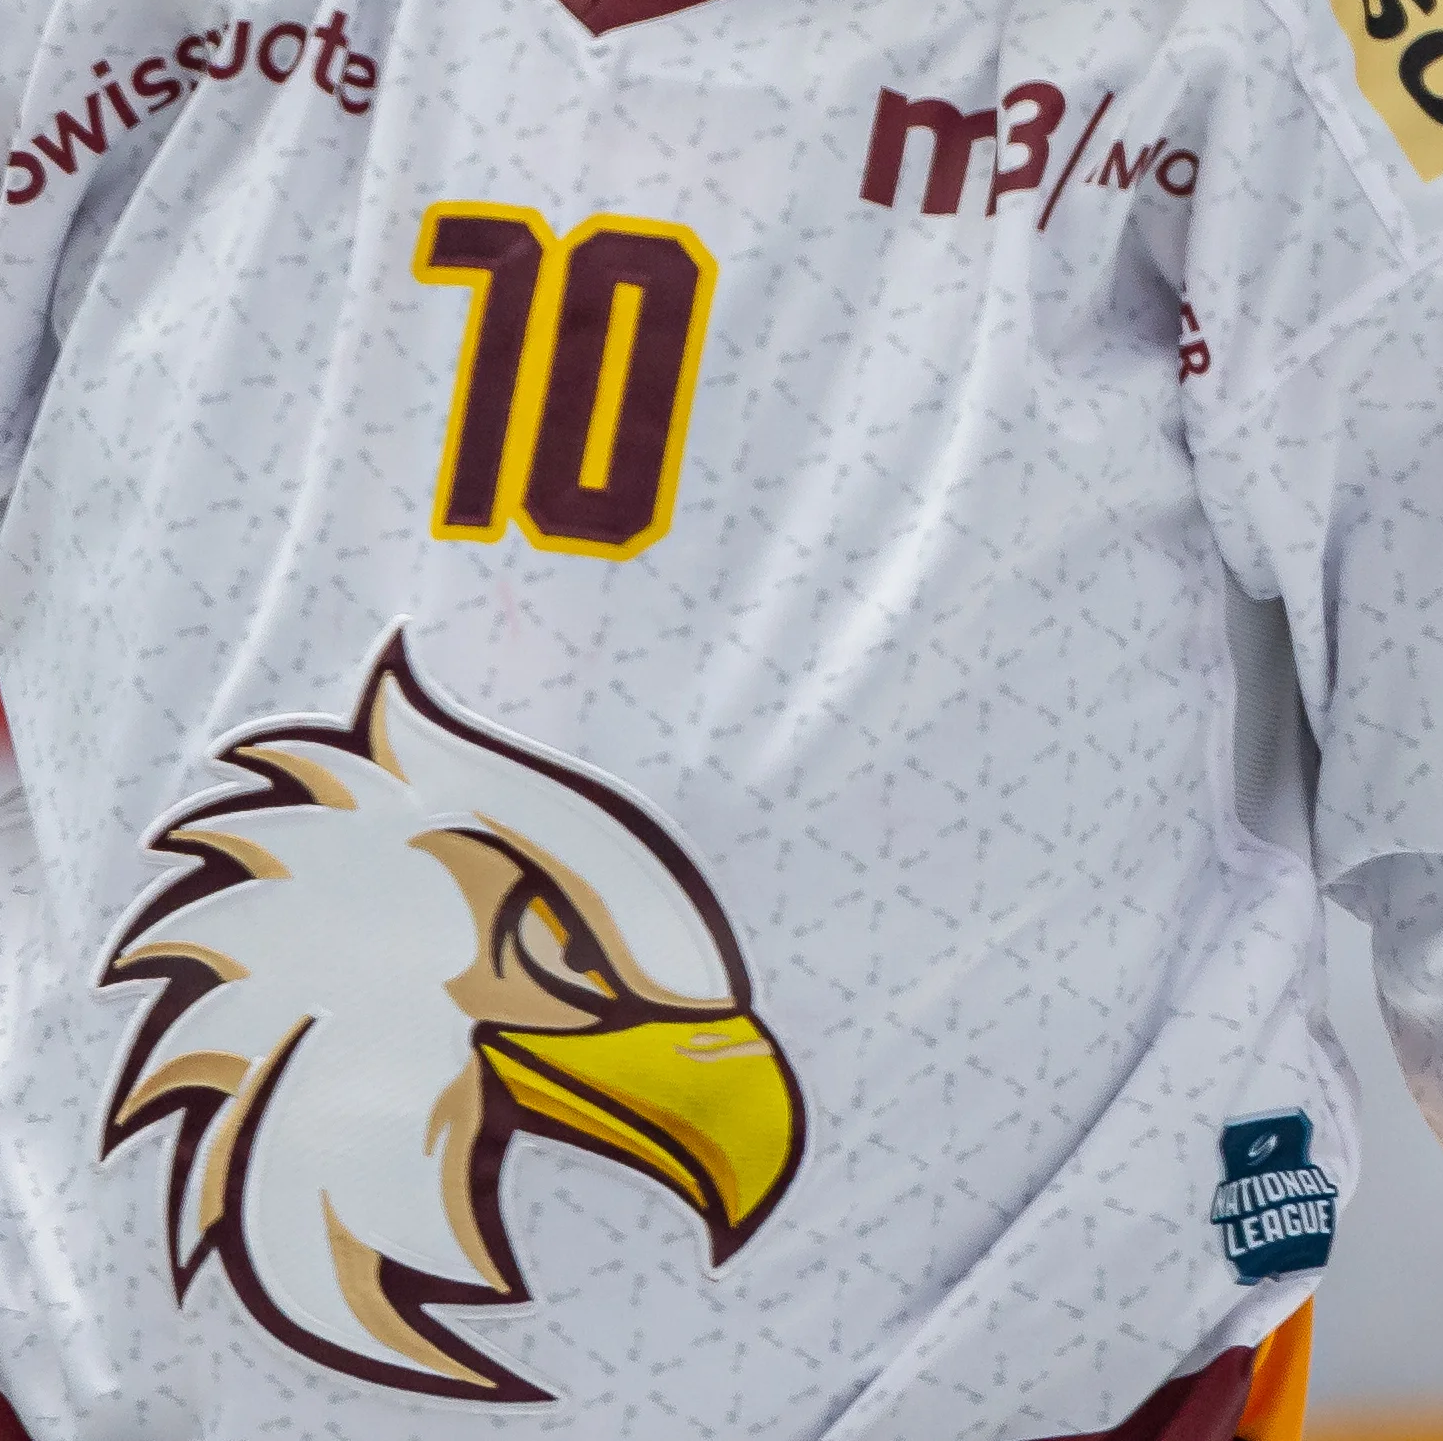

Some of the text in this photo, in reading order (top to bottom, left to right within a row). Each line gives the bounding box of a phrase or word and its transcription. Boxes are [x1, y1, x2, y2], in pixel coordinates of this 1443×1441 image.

[410, 199, 720, 564] 70
[1211, 1167, 1338, 1219] NATIONAL
[1224, 1198, 1332, 1258] LEAGUE
